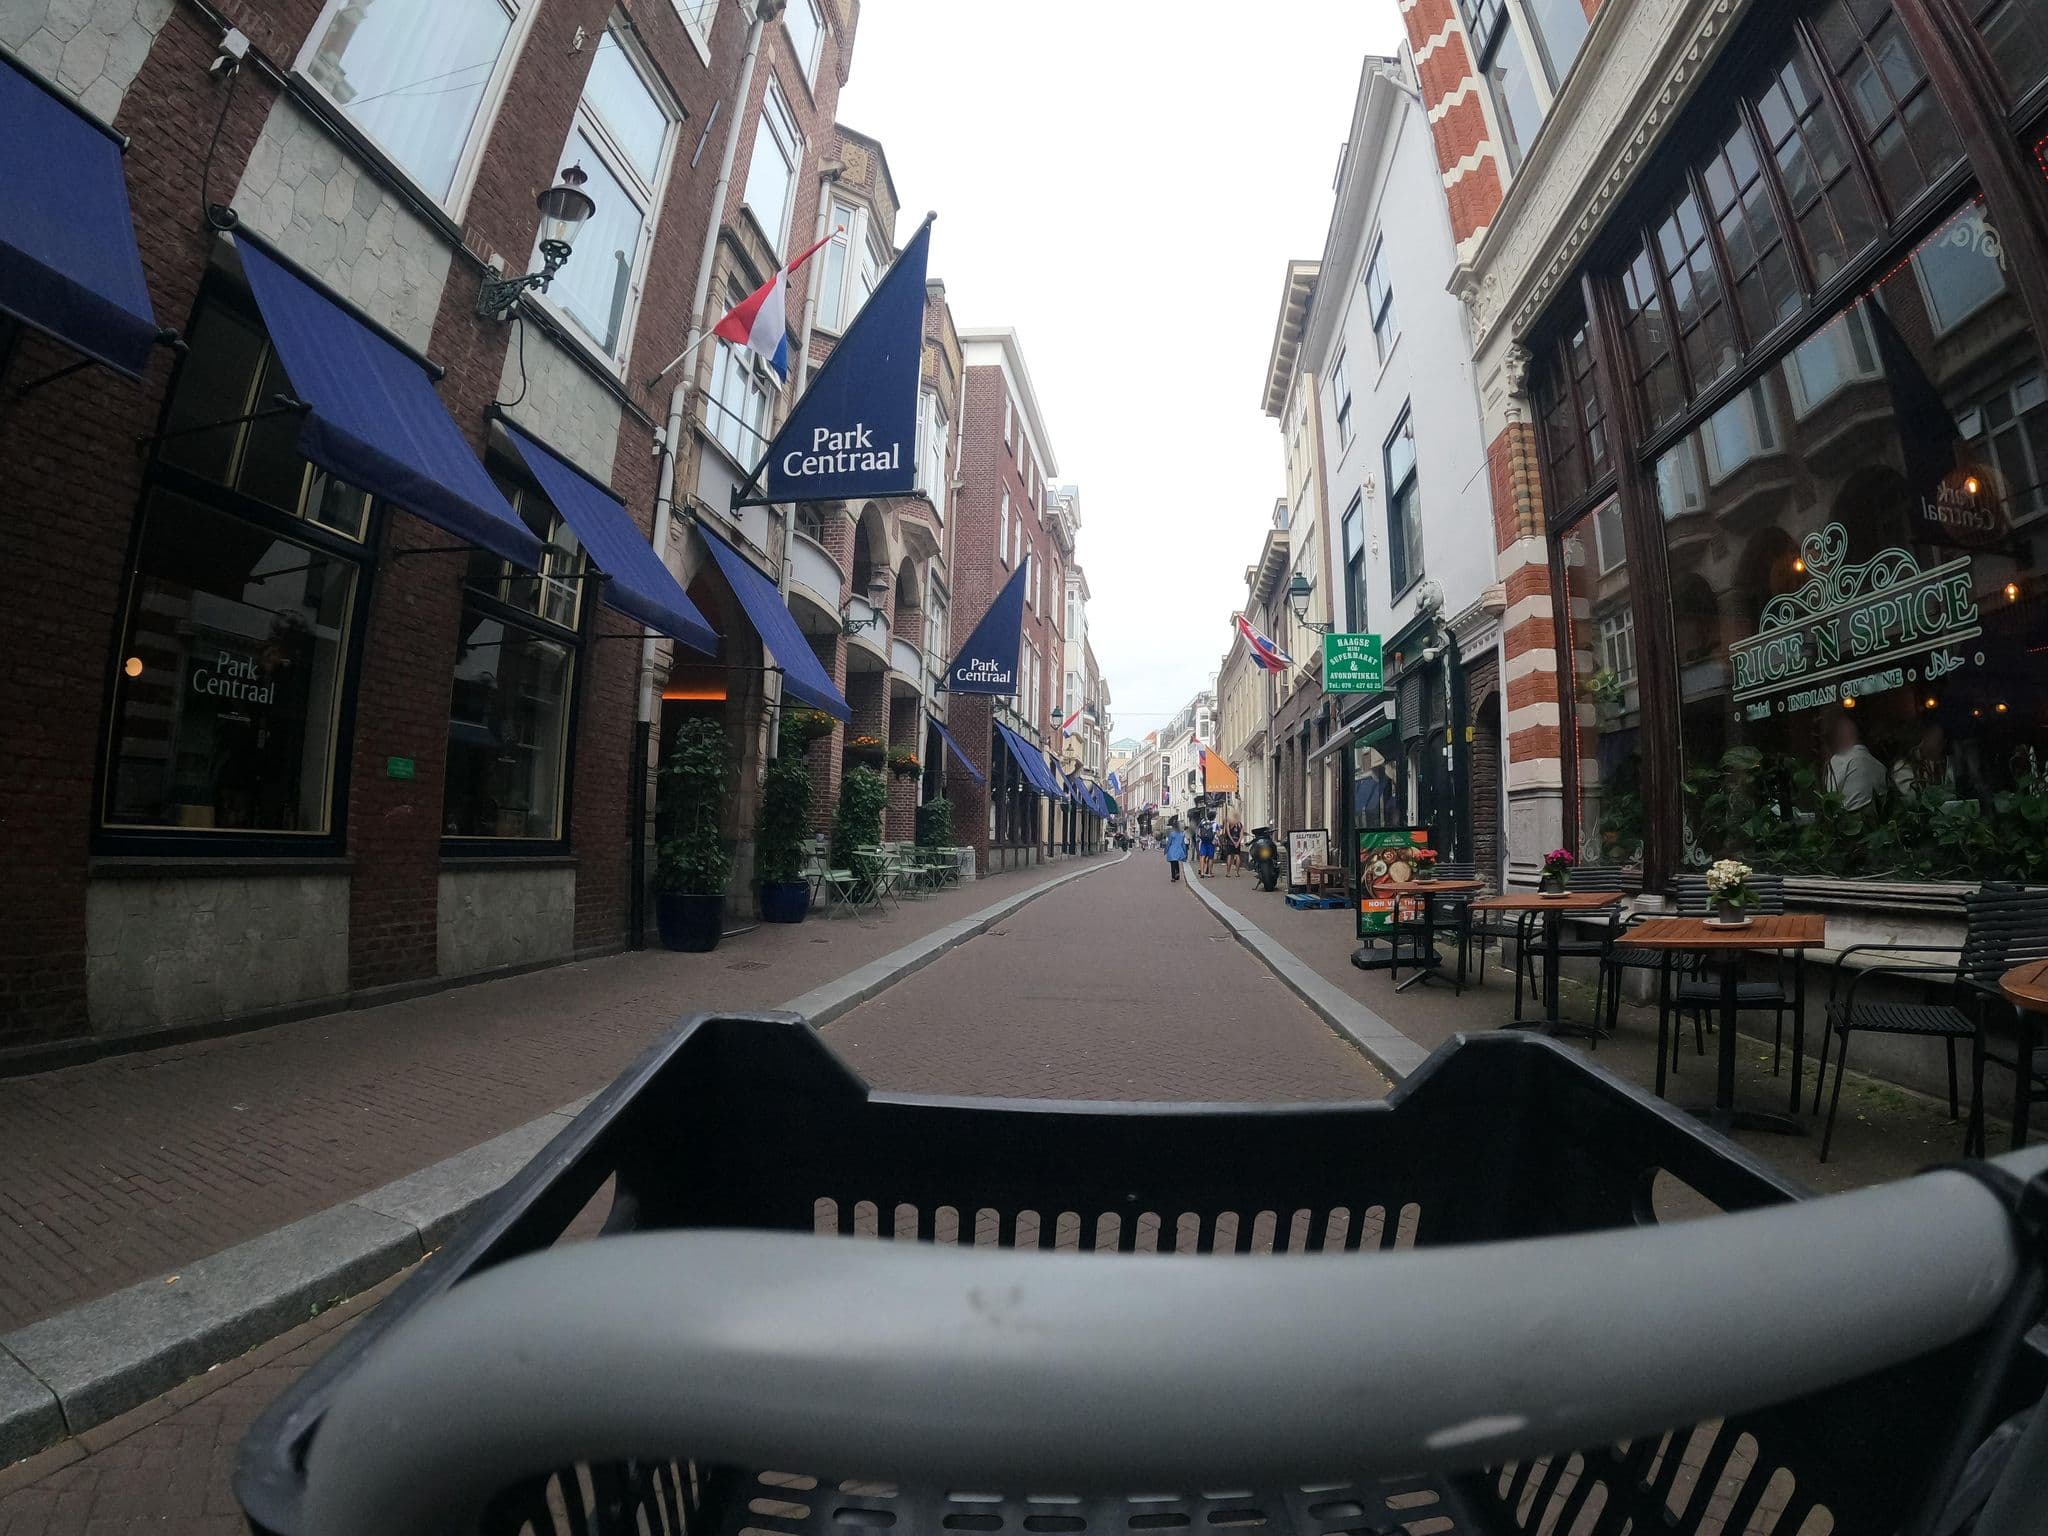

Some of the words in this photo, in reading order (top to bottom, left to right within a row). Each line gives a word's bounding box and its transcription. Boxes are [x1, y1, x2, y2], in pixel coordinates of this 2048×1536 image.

[812, 423, 873, 452] Park
[783, 442, 900, 477] Centraal
[1337, 638, 1370, 647] HAAGSE
[1730, 632, 1807, 690] RICE
[1812, 619, 1840, 667] N
[1849, 572, 1979, 657] SPICE
[217, 650, 259, 681] Park
[971, 658, 999, 672] Park
[1329, 652, 1378, 665] SUPERMARKT
[1350, 661, 1358, 671] &
[1925, 649, 1966, 681] حلال
[193, 668, 275, 705] Centraal
[957, 668, 1011, 683] Centraal
[1787, 684, 1837, 712] INDIAN
[1840, 667, 1904, 698] CUNE
